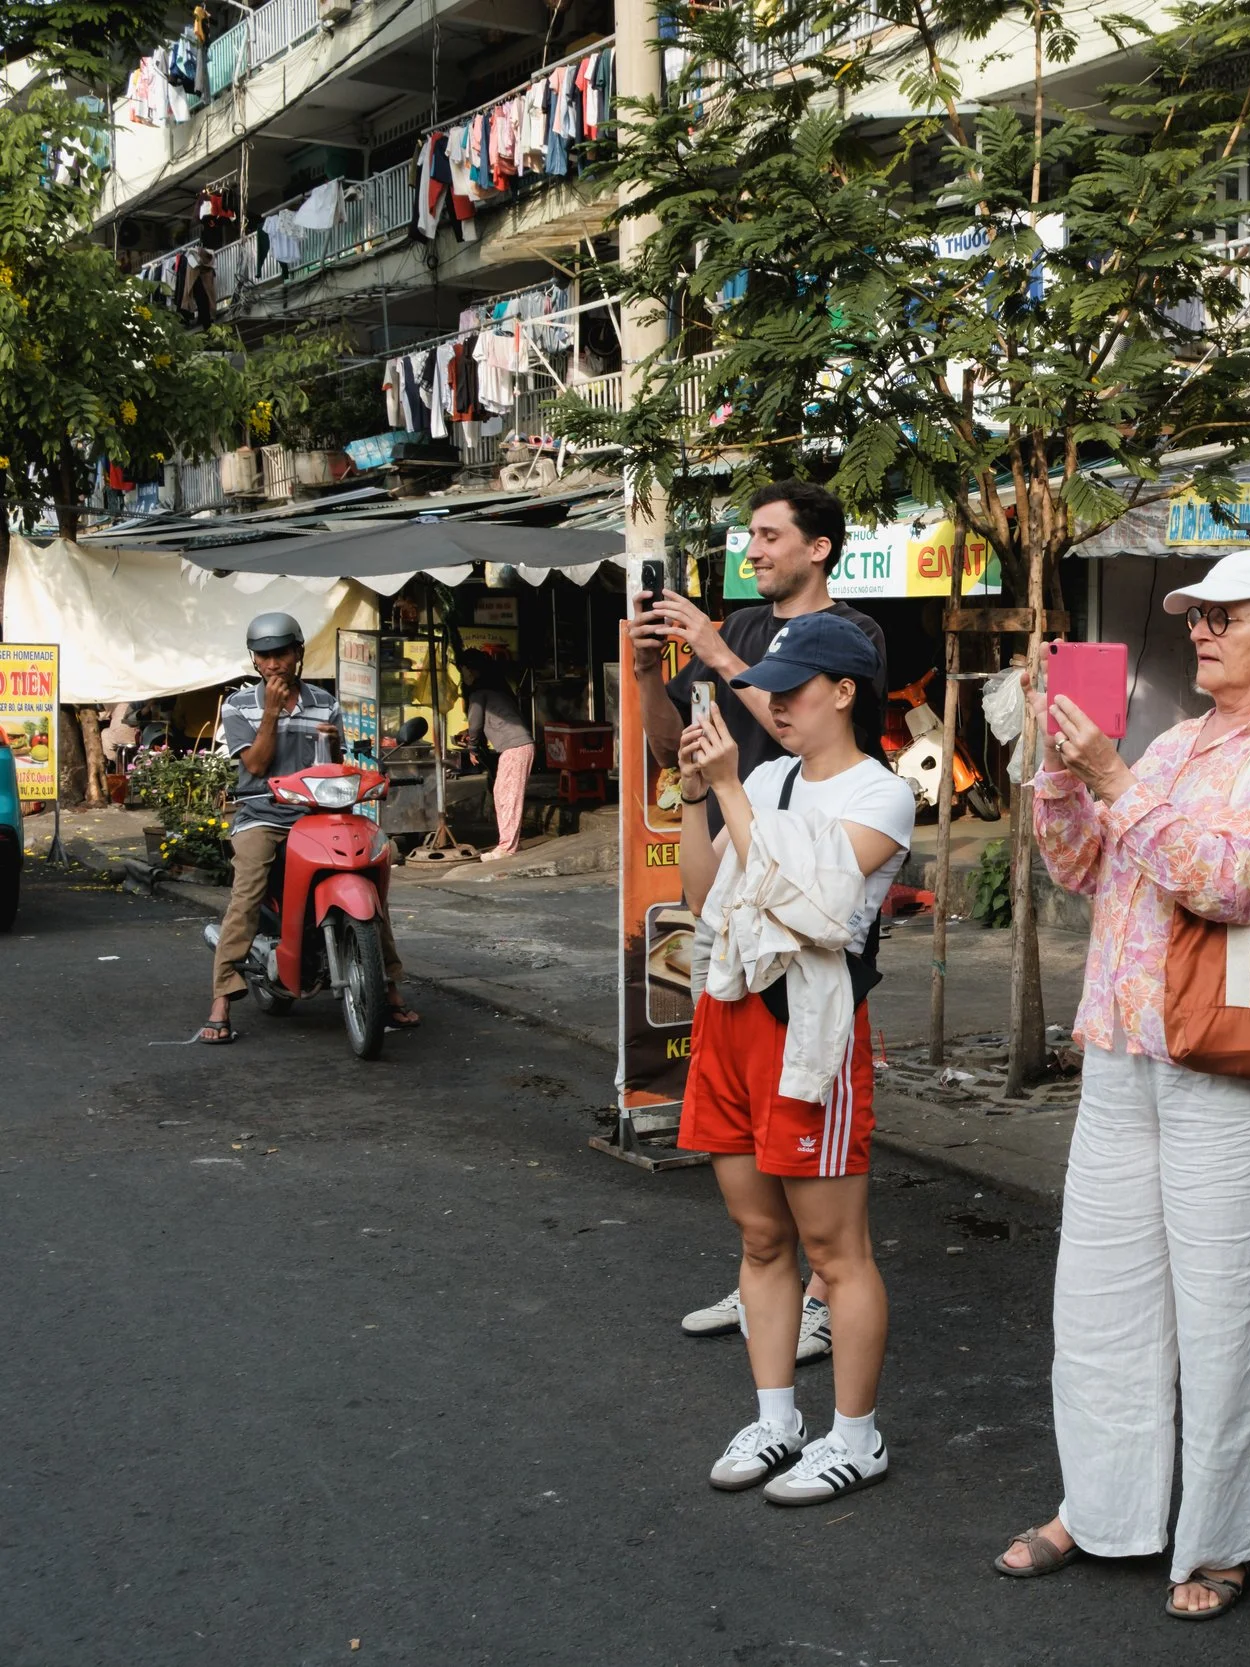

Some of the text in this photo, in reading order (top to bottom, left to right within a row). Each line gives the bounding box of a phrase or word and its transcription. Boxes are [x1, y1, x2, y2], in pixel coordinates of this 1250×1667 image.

[860, 544, 893, 580] TRÍ
[13, 651, 54, 661] HOMEMADE
[10, 664, 52, 697] TIÊN
[667, 1037, 692, 1059] KE
